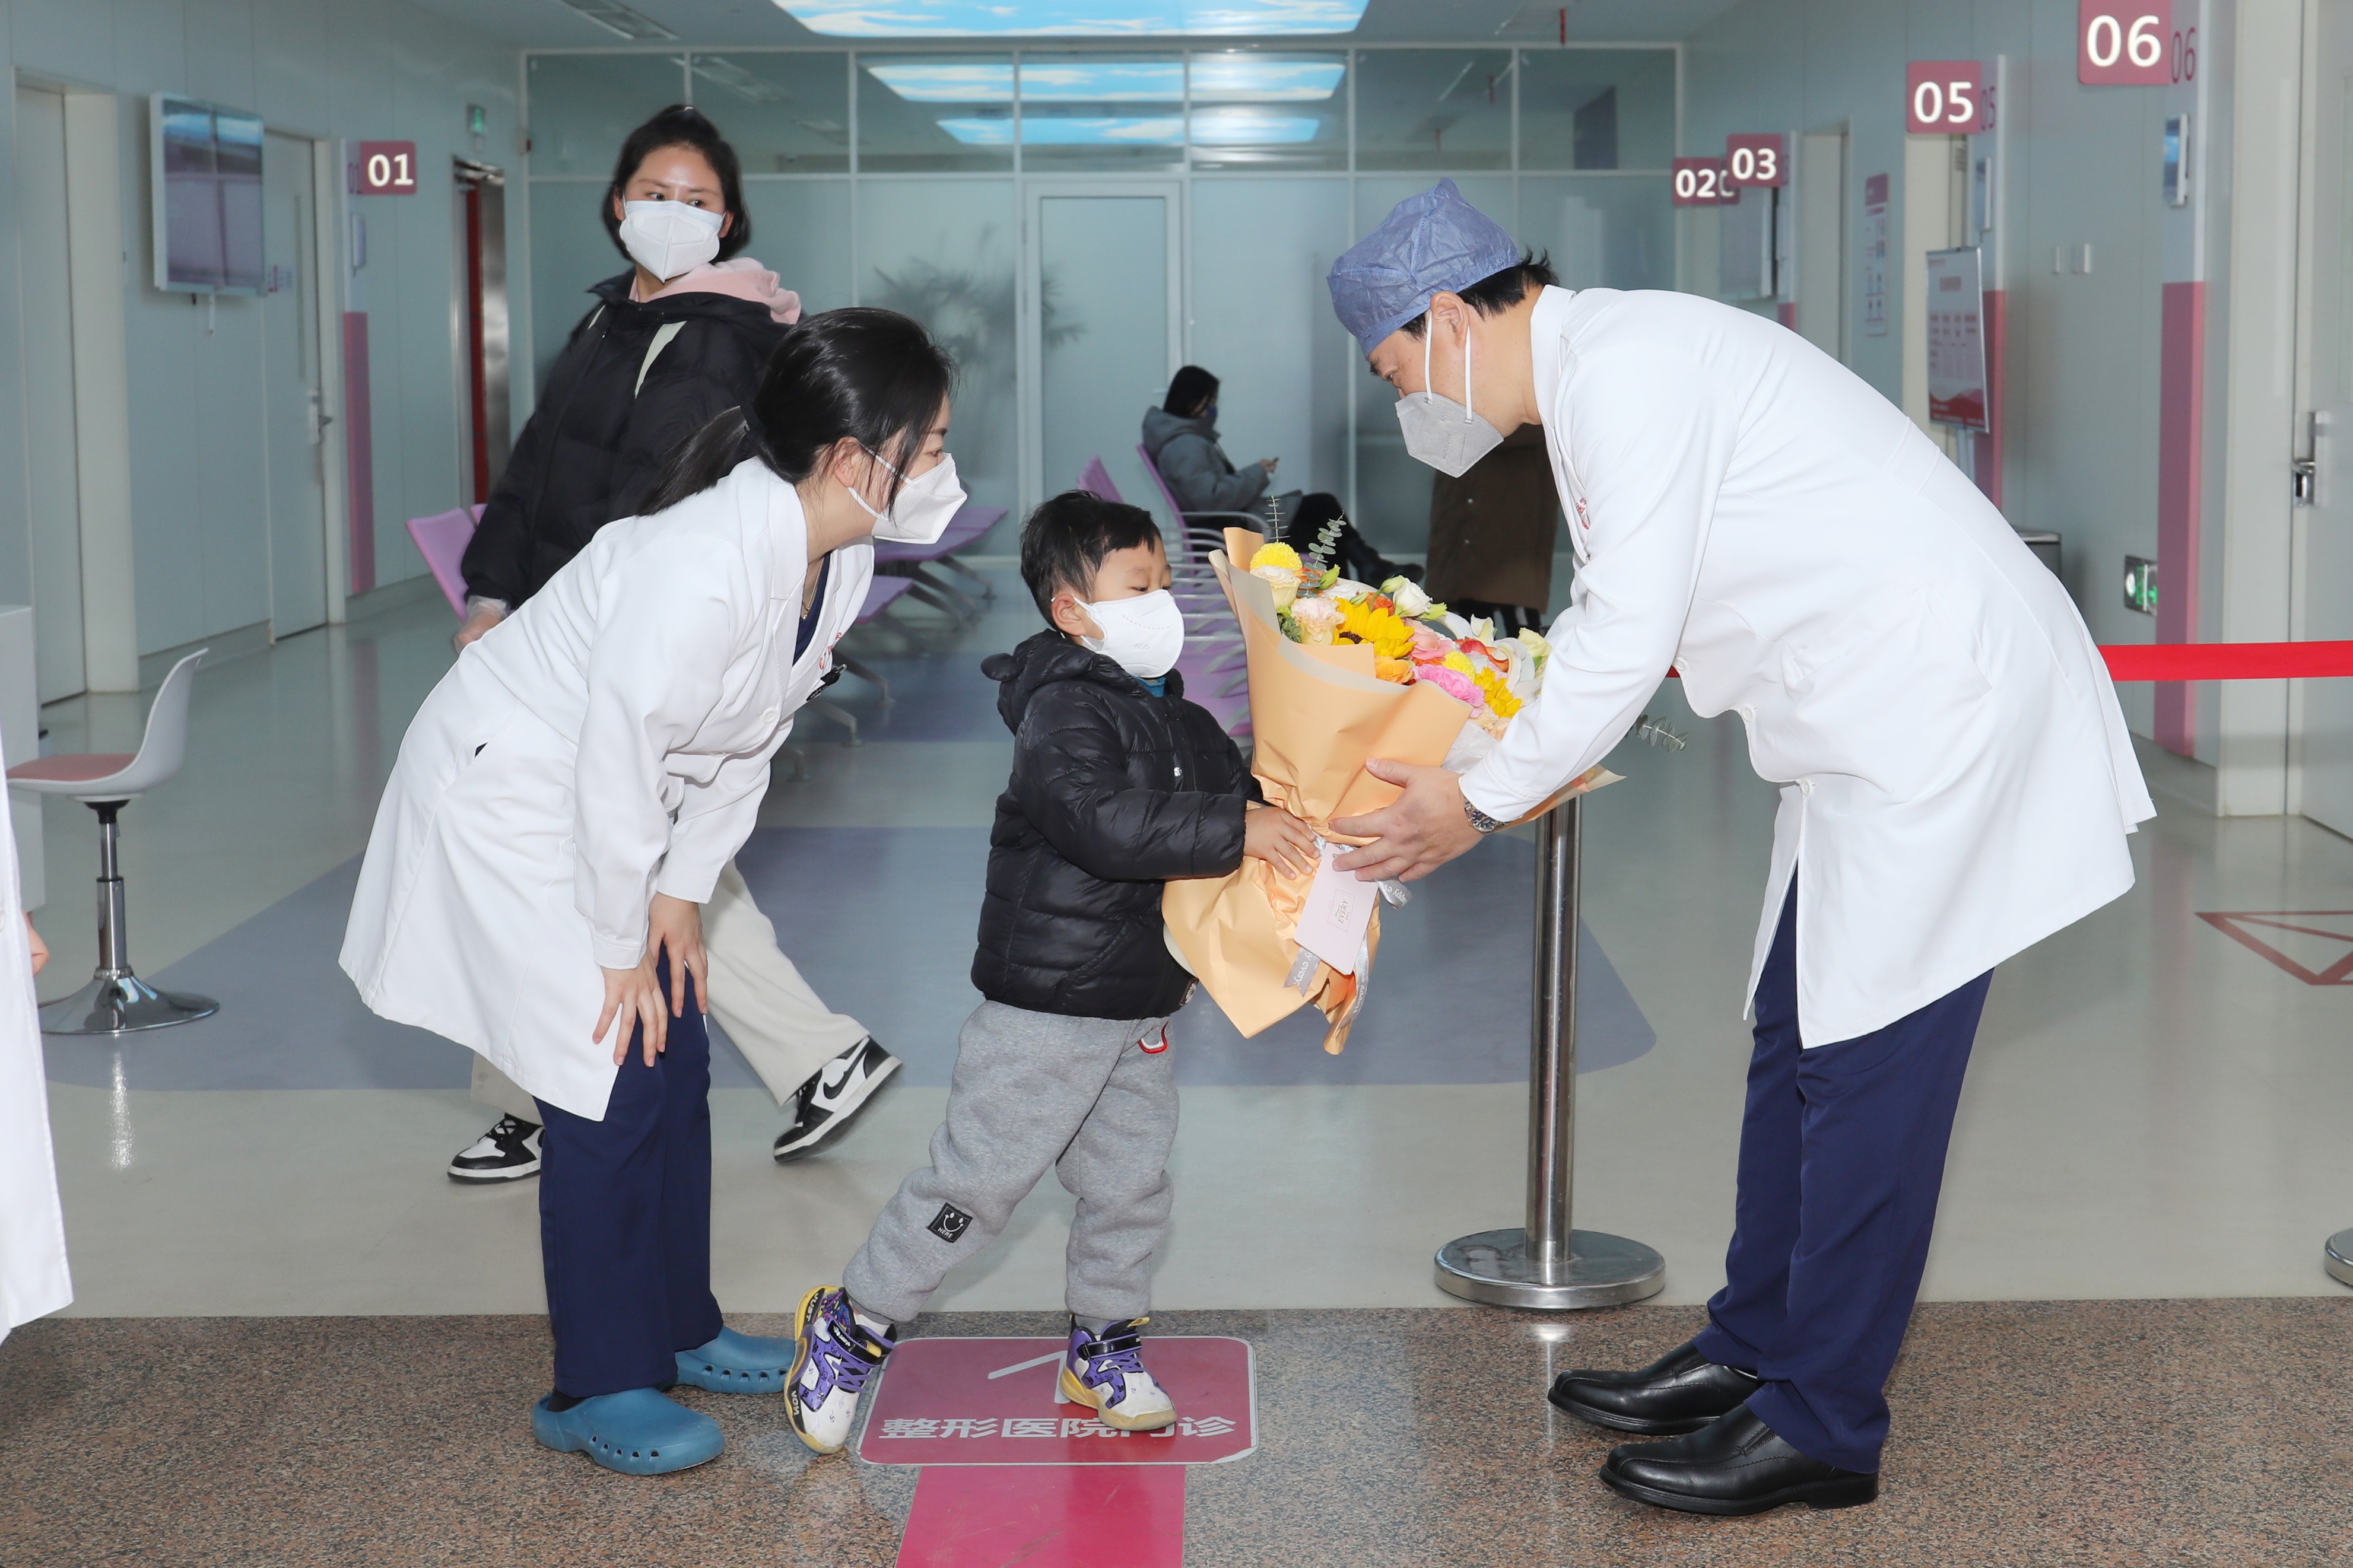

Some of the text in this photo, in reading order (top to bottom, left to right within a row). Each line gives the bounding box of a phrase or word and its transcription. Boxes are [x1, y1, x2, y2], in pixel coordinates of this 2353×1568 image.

[2087, 14, 2162, 68] 06
[2171, 26, 2196, 84] 06
[1914, 81, 1974, 123] 05
[368, 153, 414, 187] 01
[1732, 147, 1777, 180] 03
[1675, 168, 1716, 198] 02
[1338, 898, 1349, 924] EVERY
[937, 1226, 954, 1239] HERE
[806, 1293, 819, 1322] JUST
